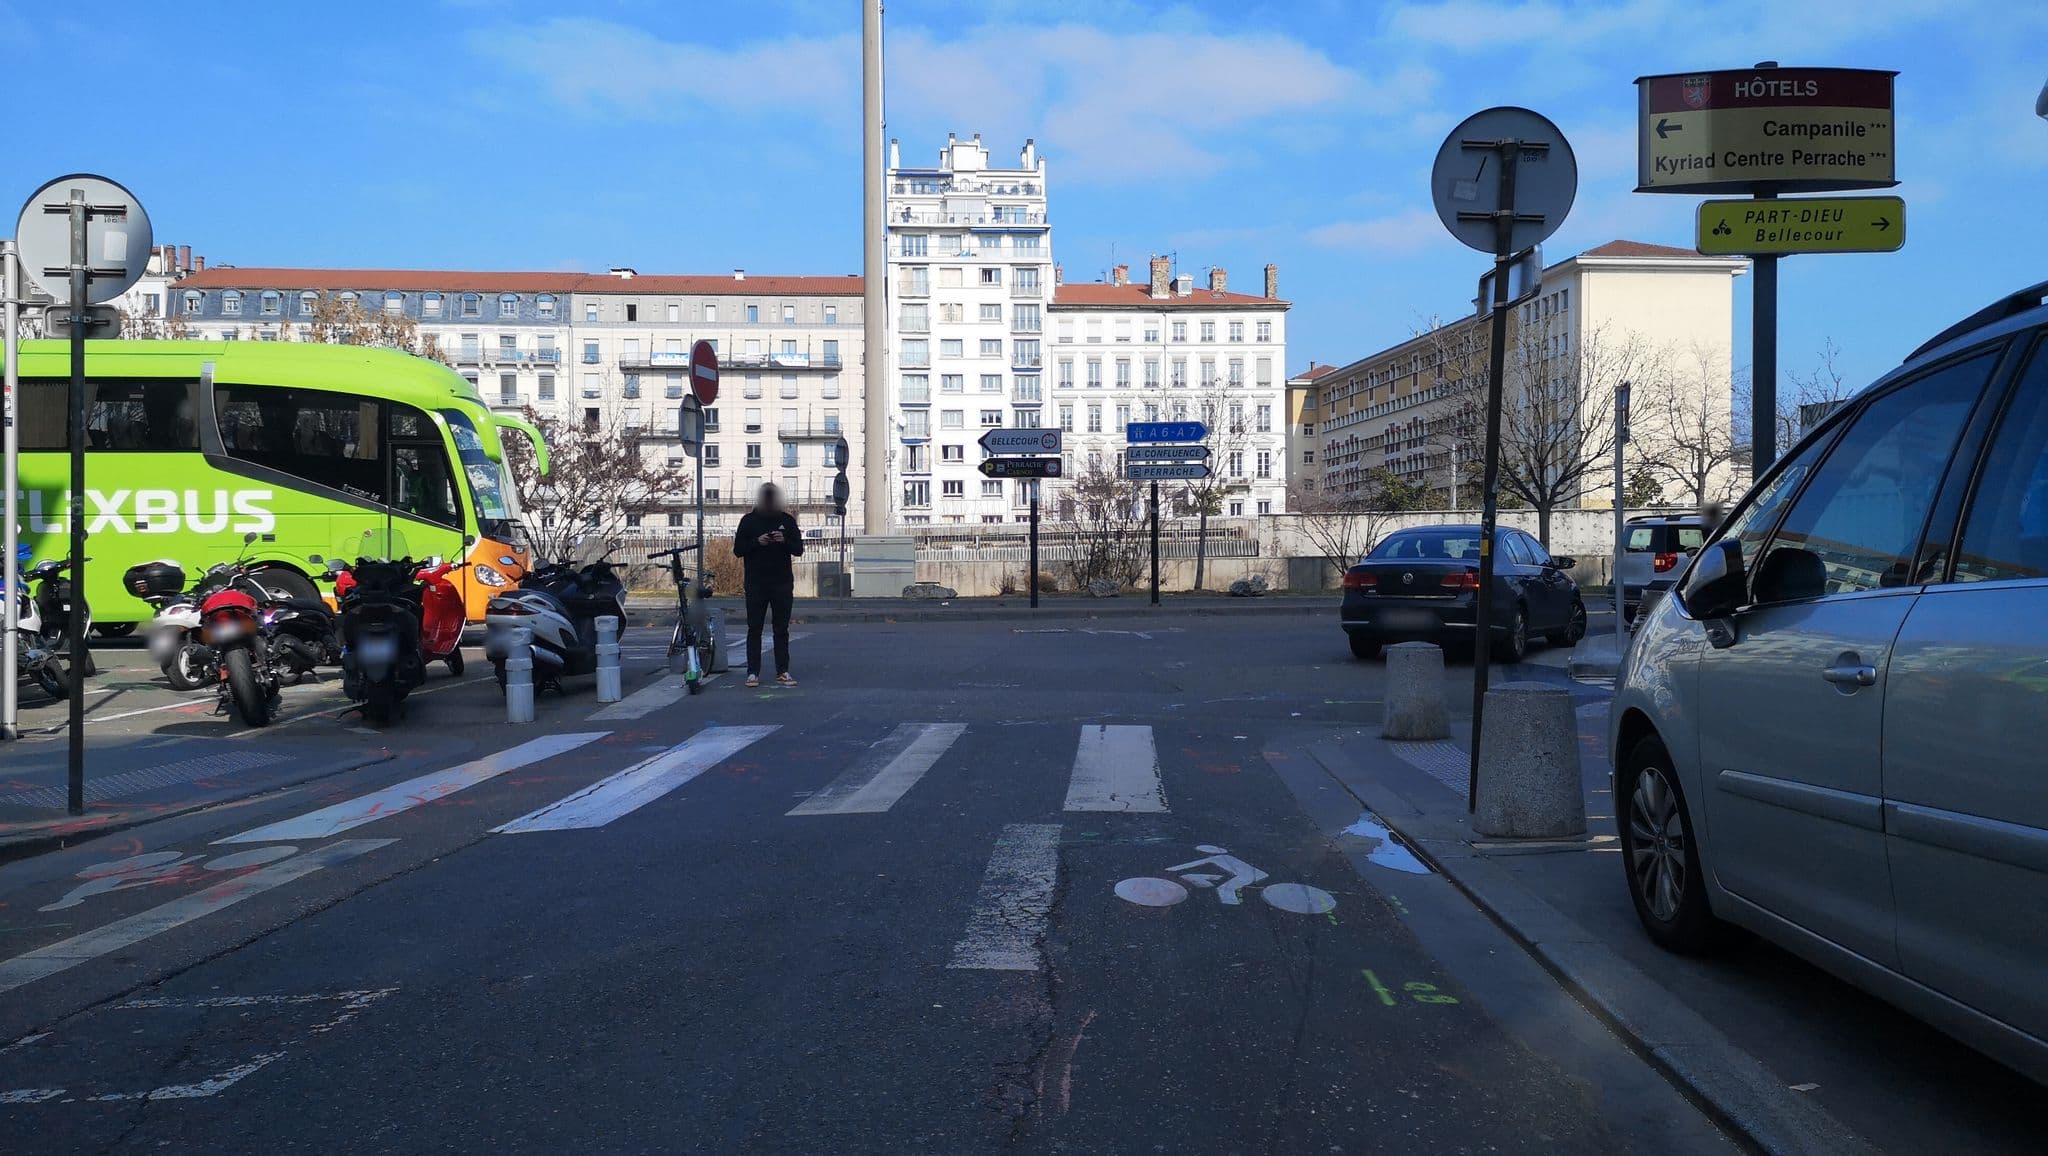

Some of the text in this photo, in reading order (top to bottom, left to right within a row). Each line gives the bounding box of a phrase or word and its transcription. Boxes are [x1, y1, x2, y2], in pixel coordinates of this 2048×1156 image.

[1735, 76, 1818, 98] HÔTELS
[1763, 120, 1866, 140] Campanile
[1655, 149, 1866, 175] Kyriad Centre Perrache
[1744, 208, 1844, 224] PART-DIEU
[1755, 228, 1844, 242] Bellecour
[991, 437, 1040, 446] BELLECOUR
[1130, 448, 1201, 458] LA CONFLUENCE
[1143, 467, 1195, 477] PERRACHE
